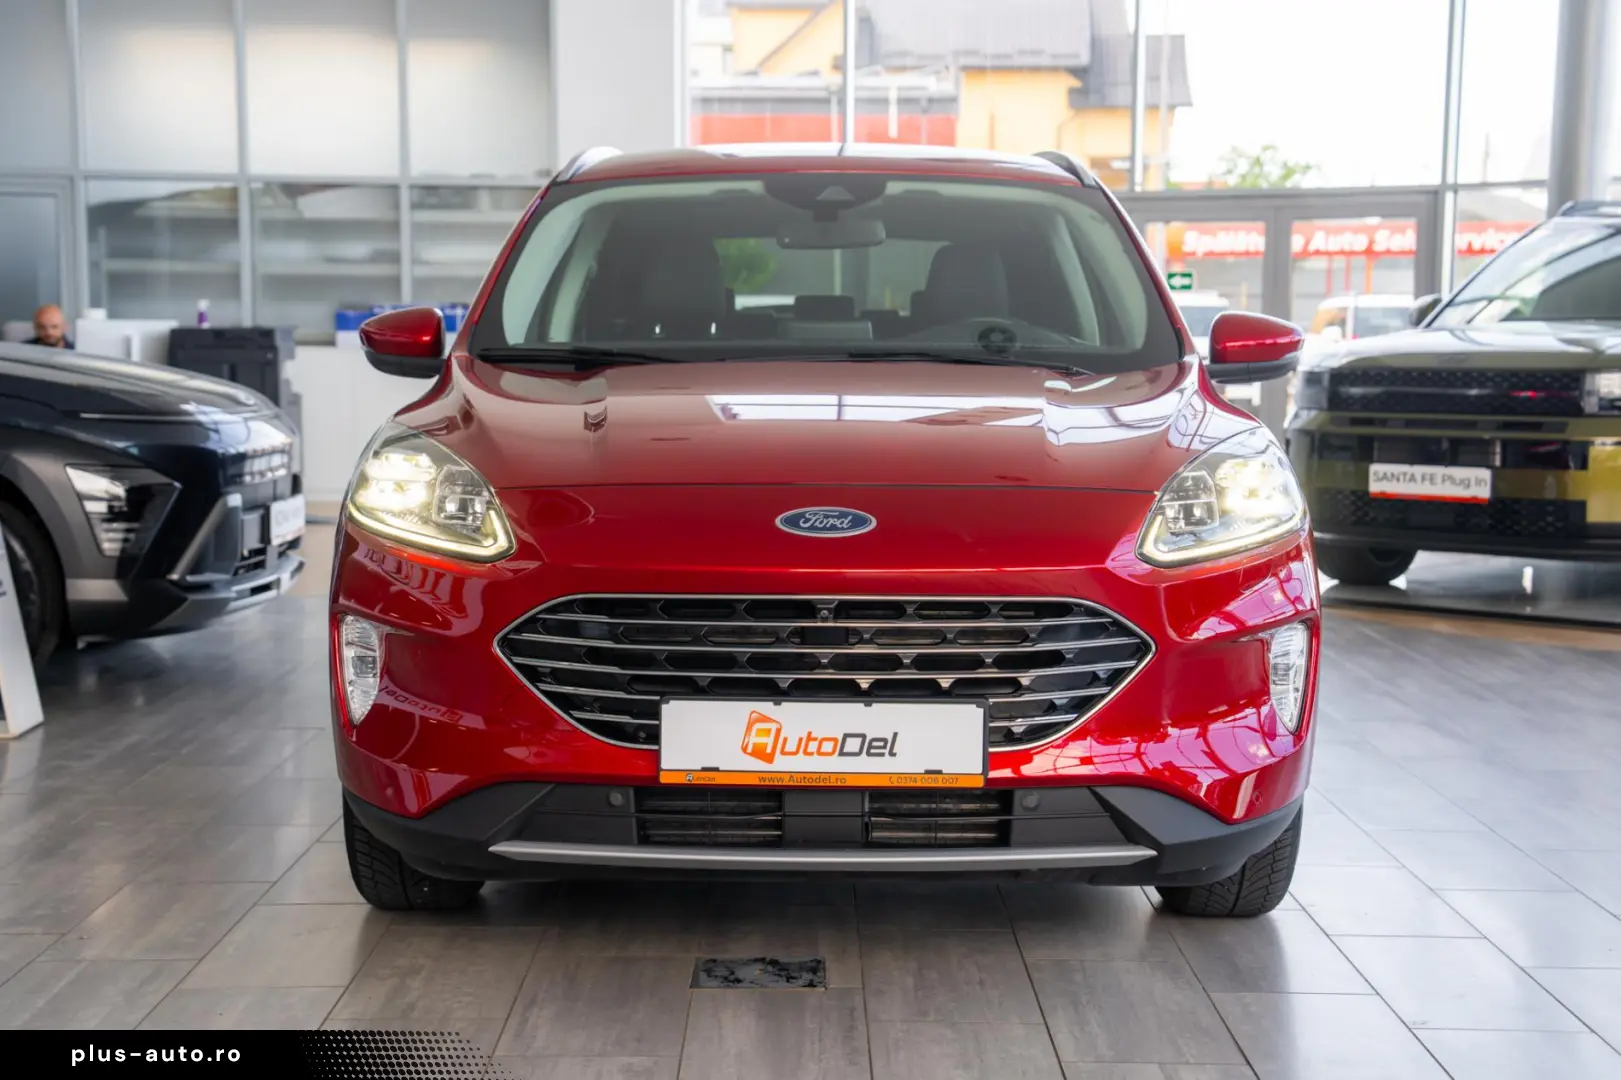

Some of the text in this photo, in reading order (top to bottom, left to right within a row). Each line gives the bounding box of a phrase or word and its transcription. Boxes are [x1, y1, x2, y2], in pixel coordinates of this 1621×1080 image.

[1308, 229, 1368, 251] Auto
[1372, 470, 1488, 489] SANTA FE Plug In
[799, 510, 853, 529] Ford
[742, 713, 899, 761] AutoDel
[757, 774, 847, 785] www.Autodel.ro
